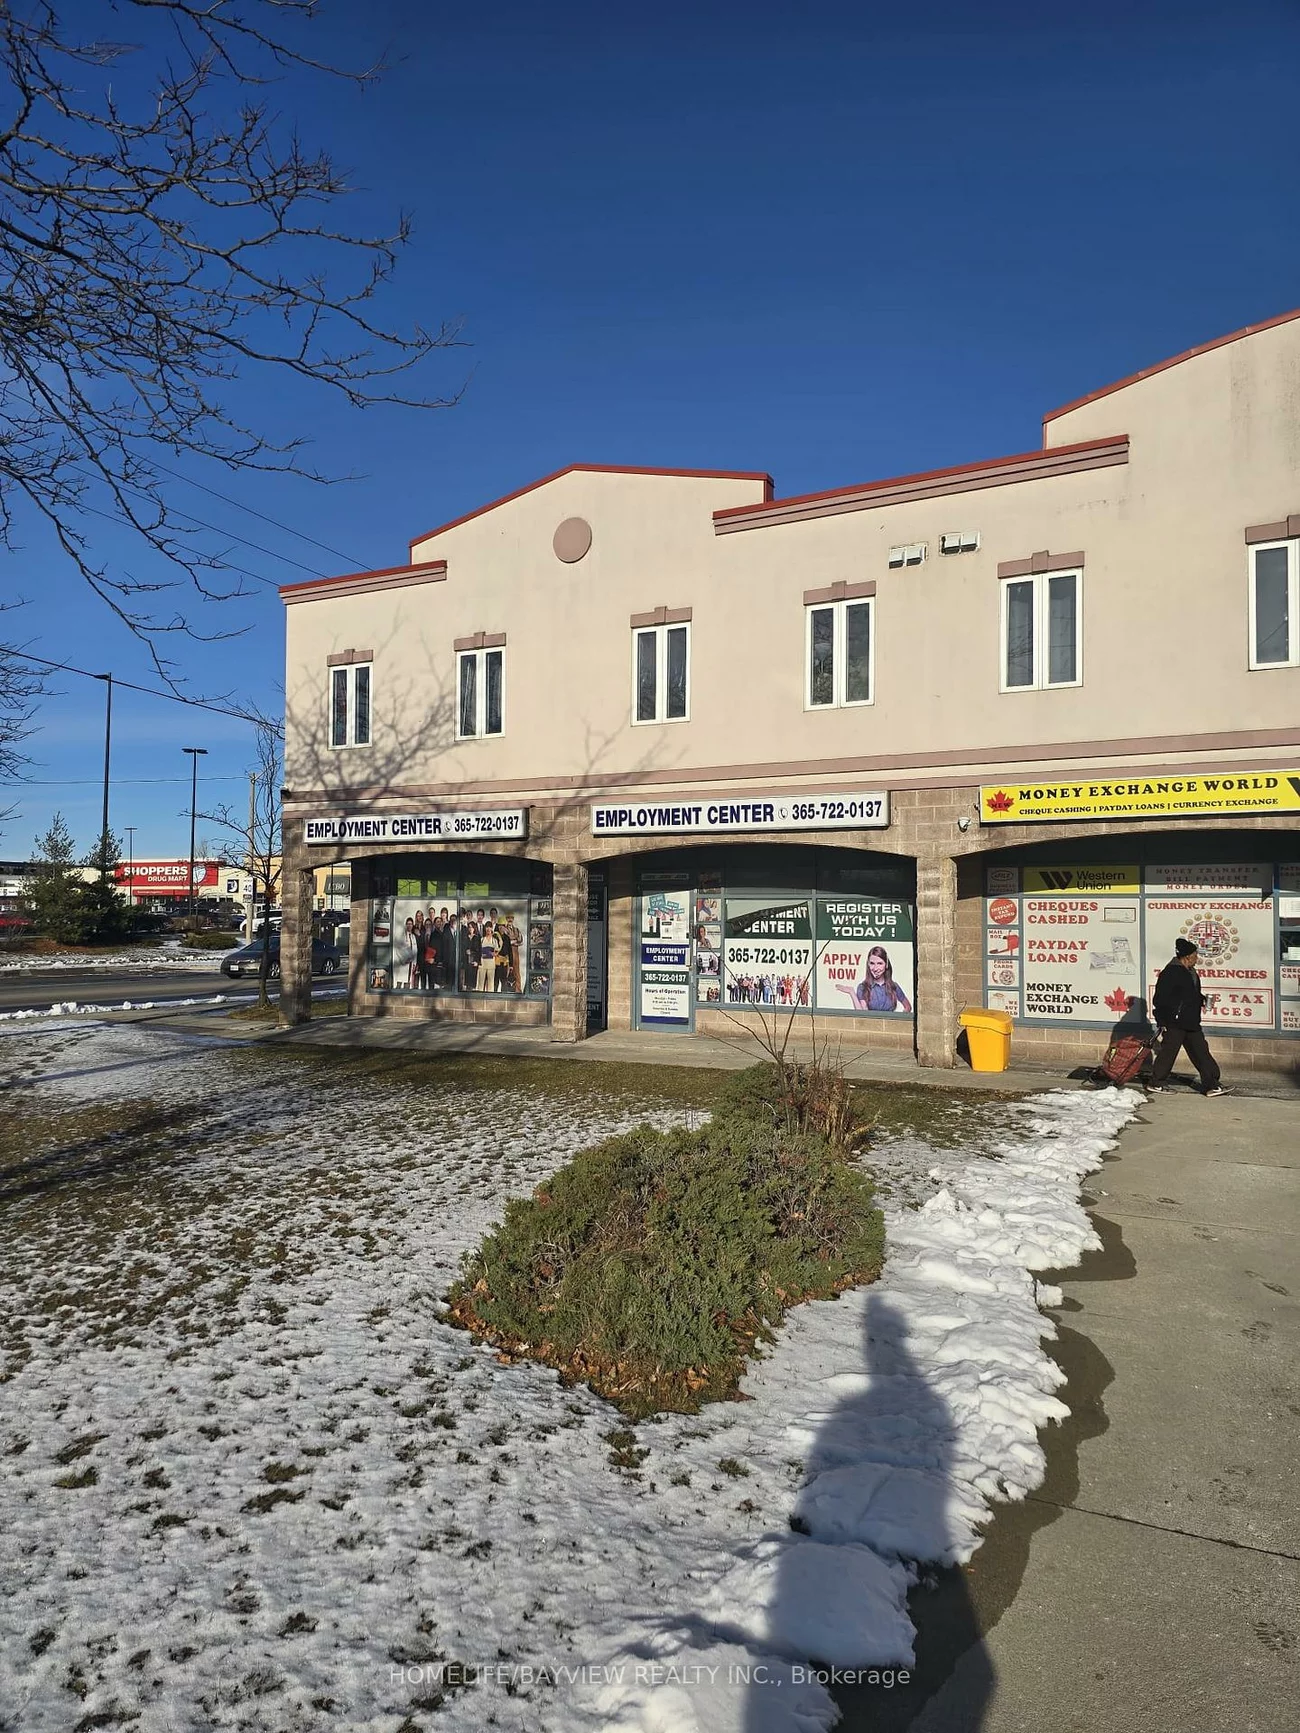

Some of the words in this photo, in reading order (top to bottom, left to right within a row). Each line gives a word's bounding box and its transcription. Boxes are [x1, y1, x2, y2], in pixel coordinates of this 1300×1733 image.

[1019, 787, 1083, 800] MONEY
[1089, 782, 1197, 796] EXCHANGE
[1203, 777, 1279, 791] WORLD
[1019, 807, 1052, 815] CHEQUE
[1053, 806, 1091, 814] CASHING
[1099, 803, 1133, 812] PAYDAY
[1173, 800, 1223, 809] CURRENCY
[1225, 798, 1278, 807] EXCHANGE
[595, 807, 702, 828] EMPLOYMENT
[707, 803, 774, 824] CENTER
[792, 800, 882, 820] 365-722-0137
[307, 820, 388, 838] EMPLOYMENT
[391, 818, 441, 836] CENTER
[454, 816, 519, 833] 365-722-0137
[124, 866, 188, 876] SHOPPERS
[1076, 871, 1125, 881] Western
[1076, 881, 1112, 891] Union
[826, 903, 902, 914] REGISTER
[1028, 901, 1098, 913] CHEQUES
[1209, 902, 1272, 910] EXCHANGE
[831, 915, 869, 925] WITH
[875, 915, 897, 925] US
[1028, 915, 1089, 924] CASHED
[832, 926, 885, 937] TODAY
[1028, 940, 1089, 950] PAYDAY
[646, 947, 685, 955] EMPLOYMENT
[728, 947, 810, 965] 365-722-0137
[823, 953, 861, 966] APPLY
[1028, 953, 1078, 963] LOANS
[644, 973, 686, 982] 365-722-0137
[828, 968, 857, 981] NOW
[1197, 969, 1268, 979] RRENCIES
[1026, 983, 1072, 993] MONEY
[1026, 994, 1099, 1004] EXCHANGE
[1229, 994, 1265, 1004] TAX
[1026, 1004, 1074, 1014] WORLD
